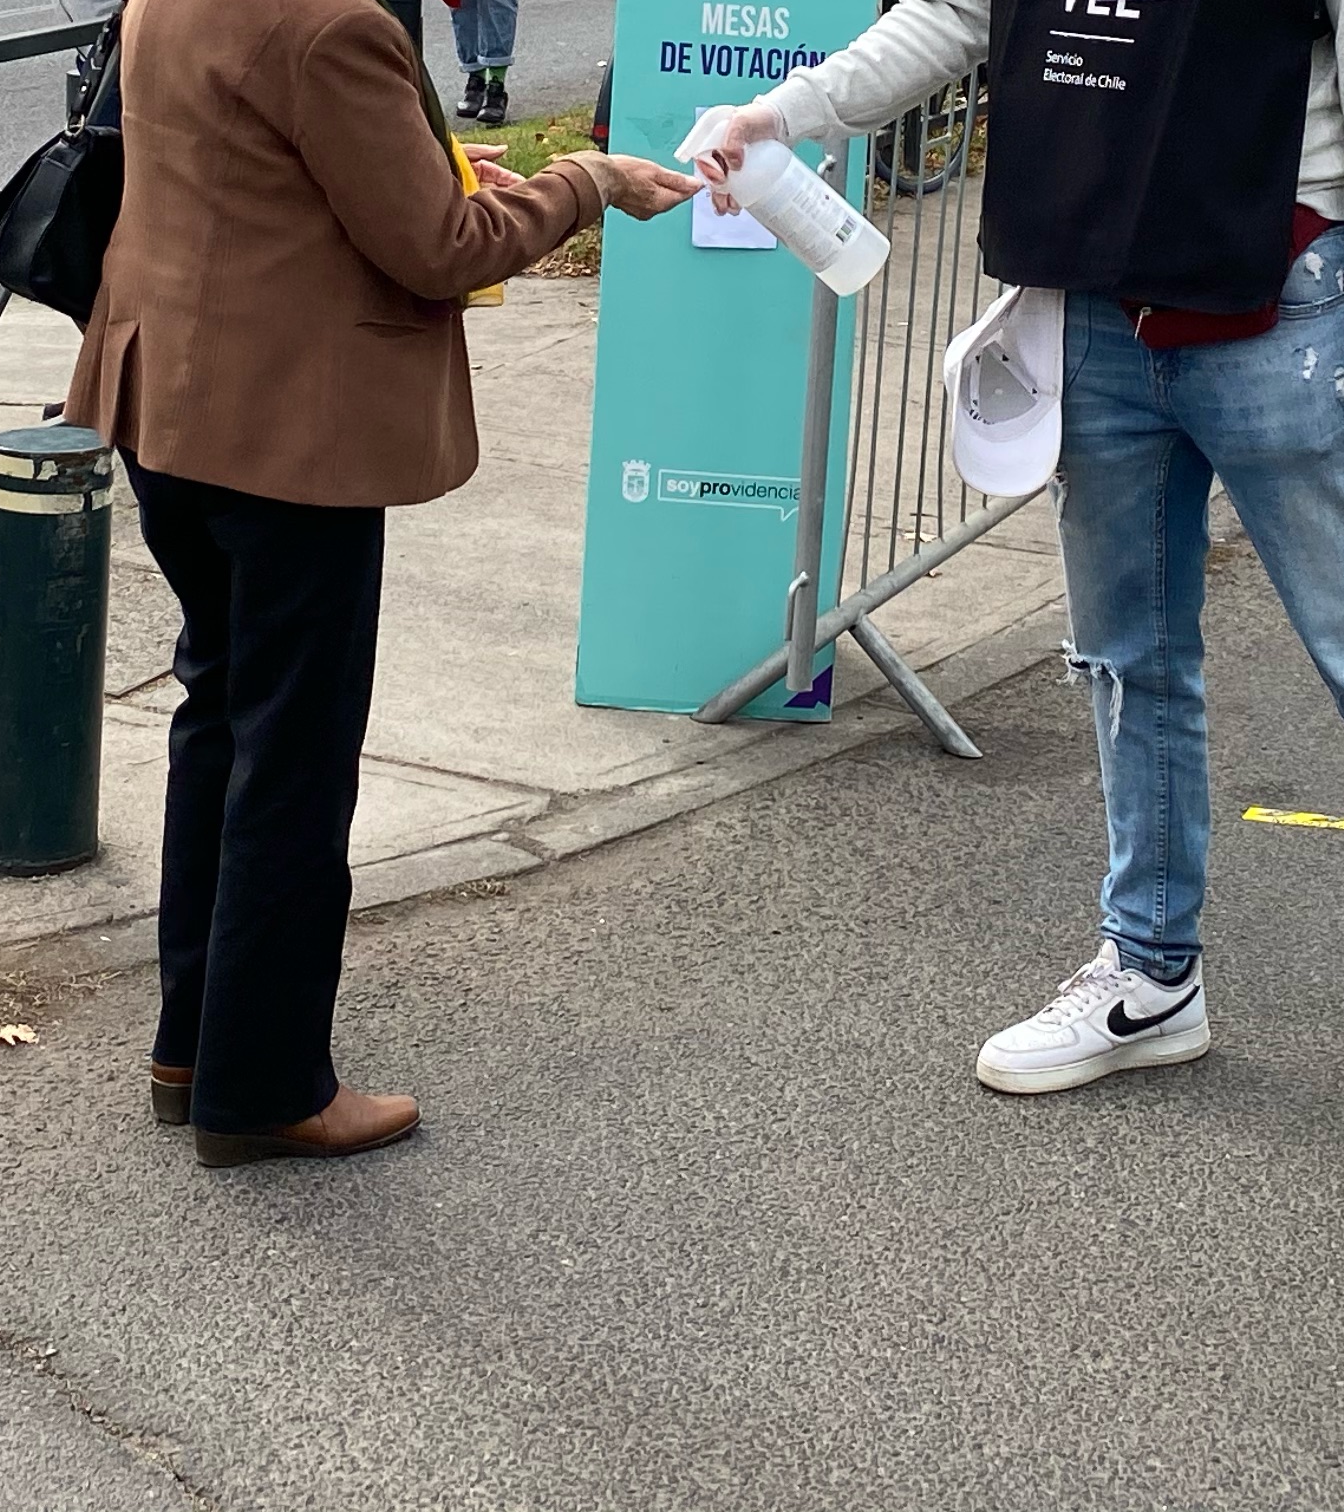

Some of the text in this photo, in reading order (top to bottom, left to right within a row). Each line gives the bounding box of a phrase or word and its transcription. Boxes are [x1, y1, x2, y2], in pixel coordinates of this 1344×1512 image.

[701, 2, 790, 39] MESAS
[660, 41, 693, 74] DE
[1045, 50, 1083, 67] Servicio
[1043, 68, 1126, 91] Electoral de Chile
